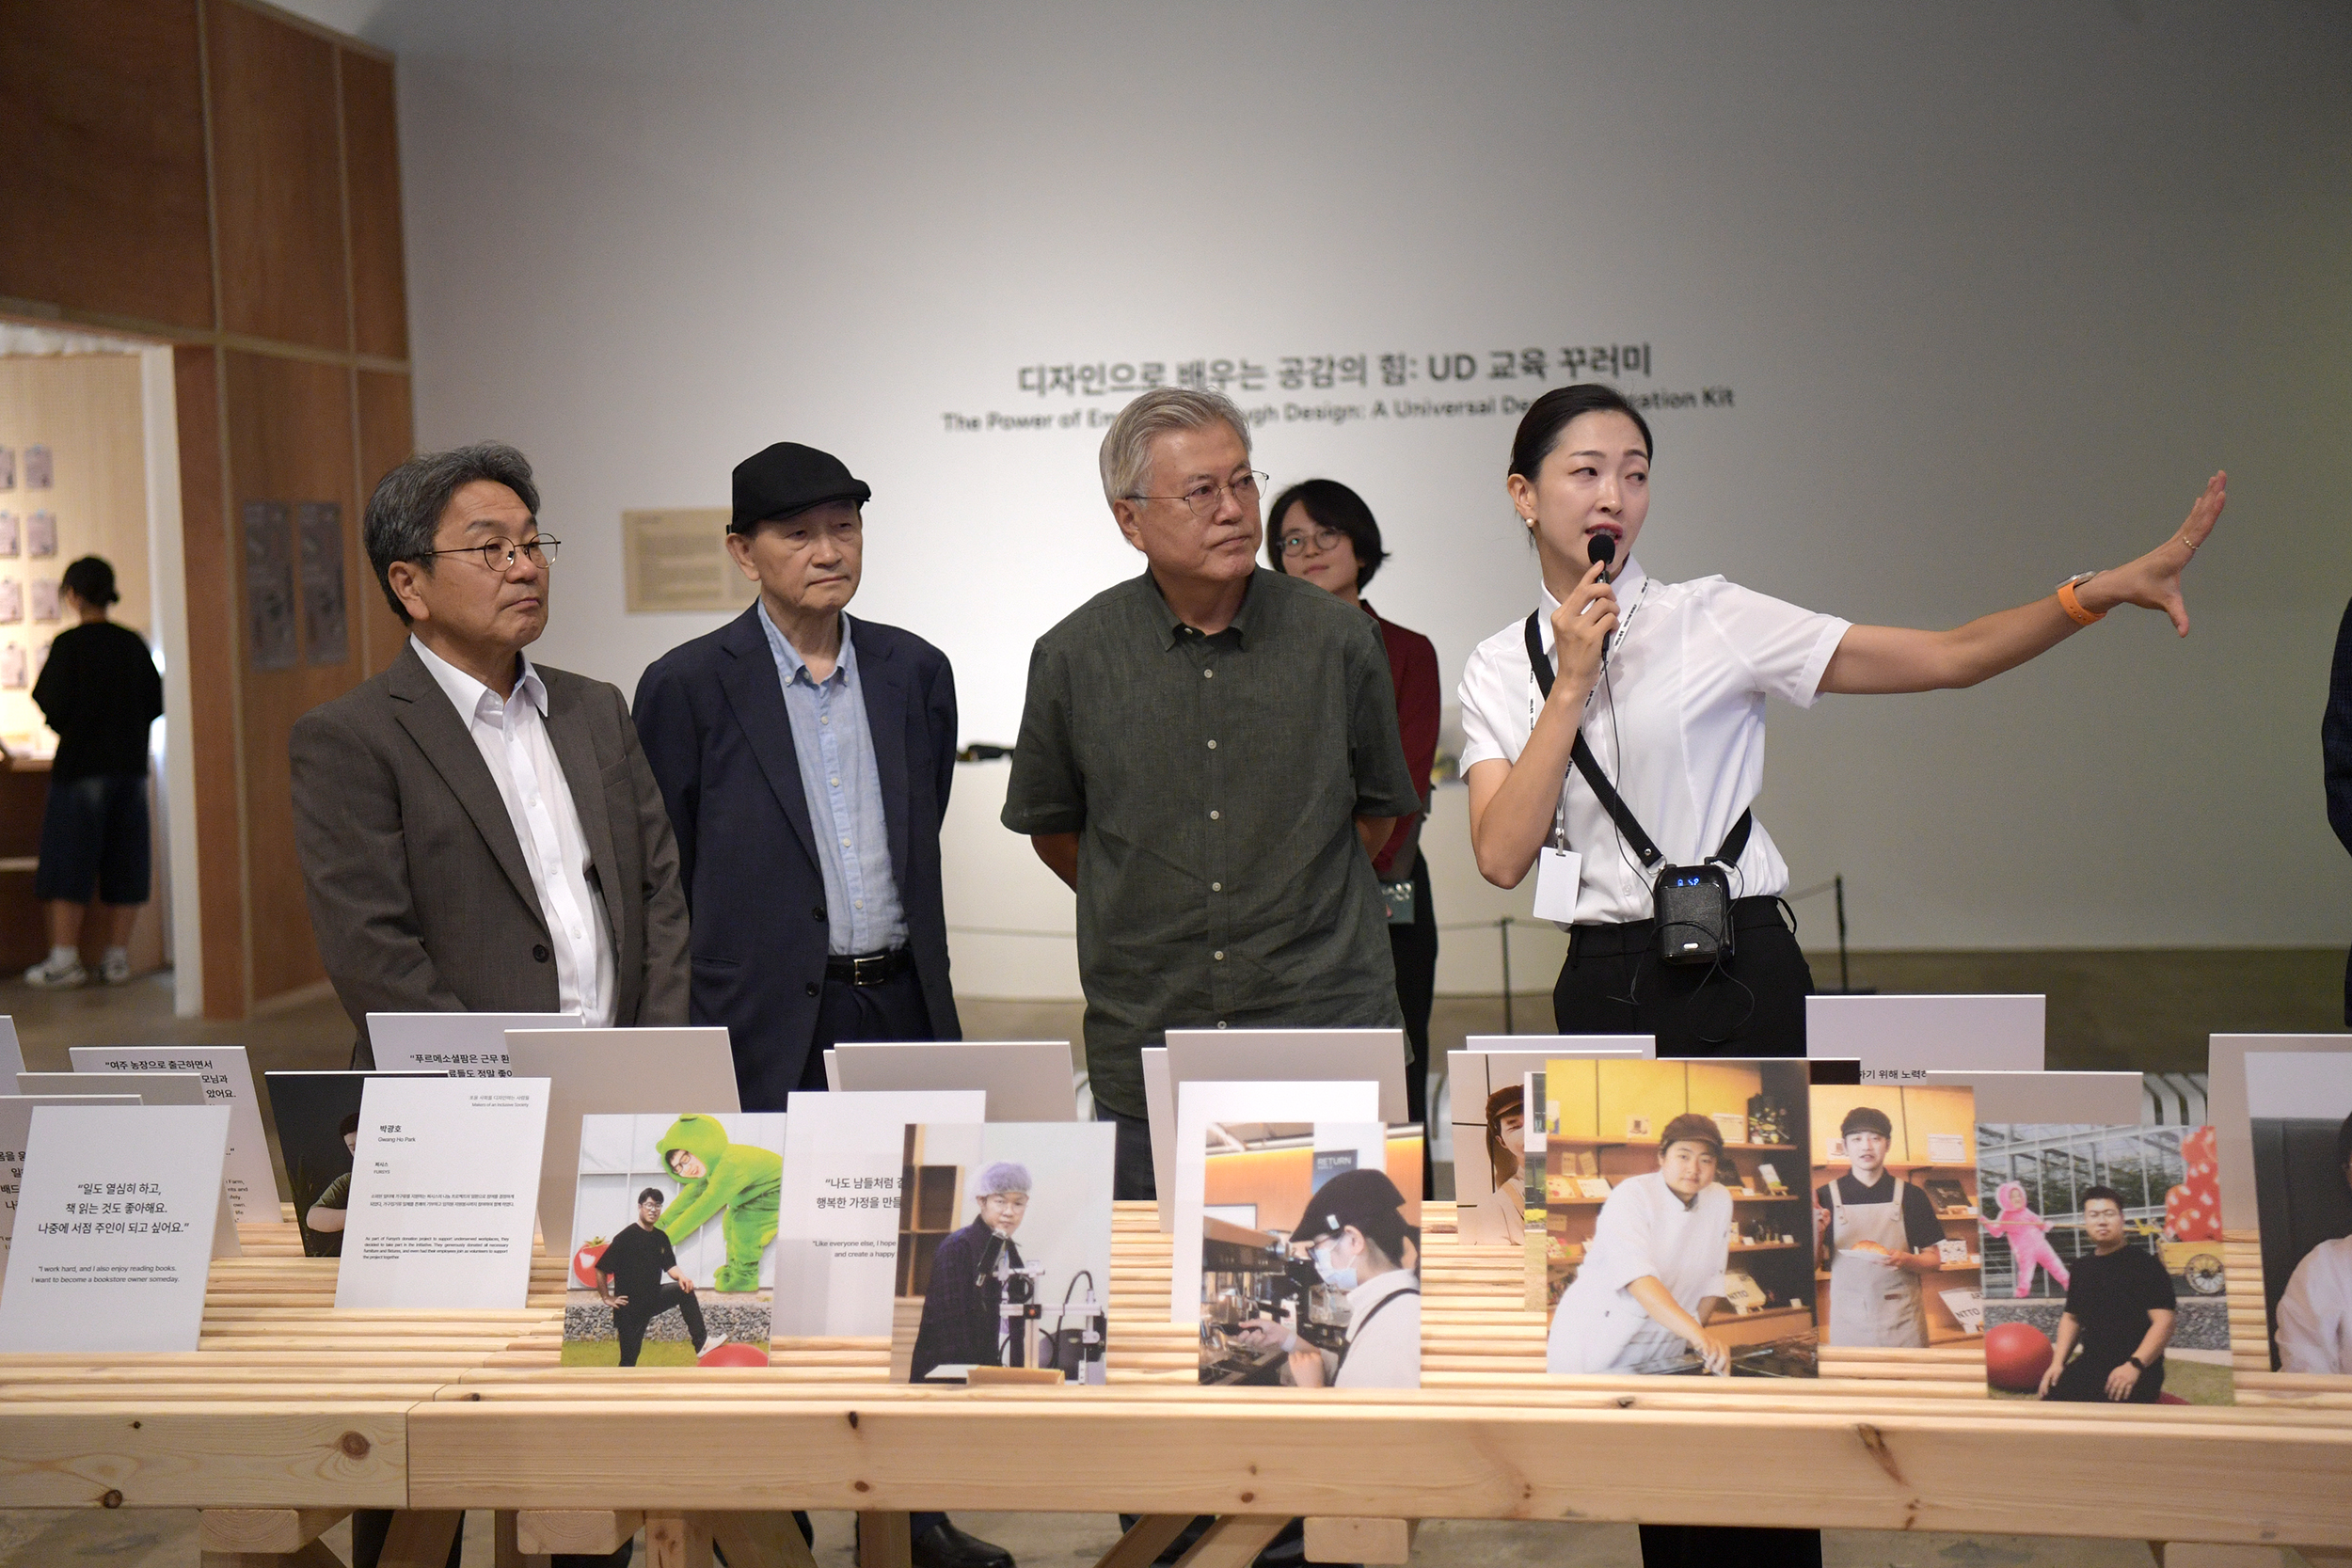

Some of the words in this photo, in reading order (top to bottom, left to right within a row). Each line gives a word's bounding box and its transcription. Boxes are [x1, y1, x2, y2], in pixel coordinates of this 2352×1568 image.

[1018, 361, 1166, 396] 디자인으로
[1176, 356, 1266, 390] 배우는
[1277, 354, 1367, 389] 공감의
[1378, 352, 1417, 387] 힘:
[1428, 353, 1477, 381] UD
[1487, 347, 1548, 381] 교육
[1559, 341, 1651, 380] 꾸러미
[943, 411, 979, 431] The
[986, 411, 1052, 430] Power
[1057, 408, 1080, 428] of
[1371, 399, 1388, 418] A
[1393, 396, 1495, 418] Universal
[1702, 386, 1734, 408] Kit
[481, 1053, 499, 1064] 근무
[501, 1053, 510, 1064] 환
[131, 1060, 167, 1069] 농장으로
[168, 1060, 213, 1069] 출근하면서
[448, 1069, 475, 1078] 료들도
[478, 1069, 495, 1078] 정말
[1879, 1069, 1899, 1079] 위해
[201, 1075, 228, 1084] 모님과
[379, 1125, 402, 1133] 박광호
[1317, 1157, 1352, 1166] RETURN
[853, 1177, 894, 1189] 남들처럼
[105, 1182, 135, 1195] 열심히
[139, 1182, 161, 1196] 하고,
[66, 1203, 75, 1214] 책
[79, 1203, 99, 1214] 읽는
[102, 1203, 121, 1214] 것도
[124, 1202, 167, 1214] 좋아해요.
[817, 1196, 847, 1209] 행복한
[850, 1196, 880, 1209] 가정을
[882, 1196, 901, 1209] 만들
[38, 1223, 69, 1234] 나중에
[72, 1223, 92, 1234] 서점
[94, 1223, 125, 1234] 주인이
[128, 1223, 148, 1233] 되고
